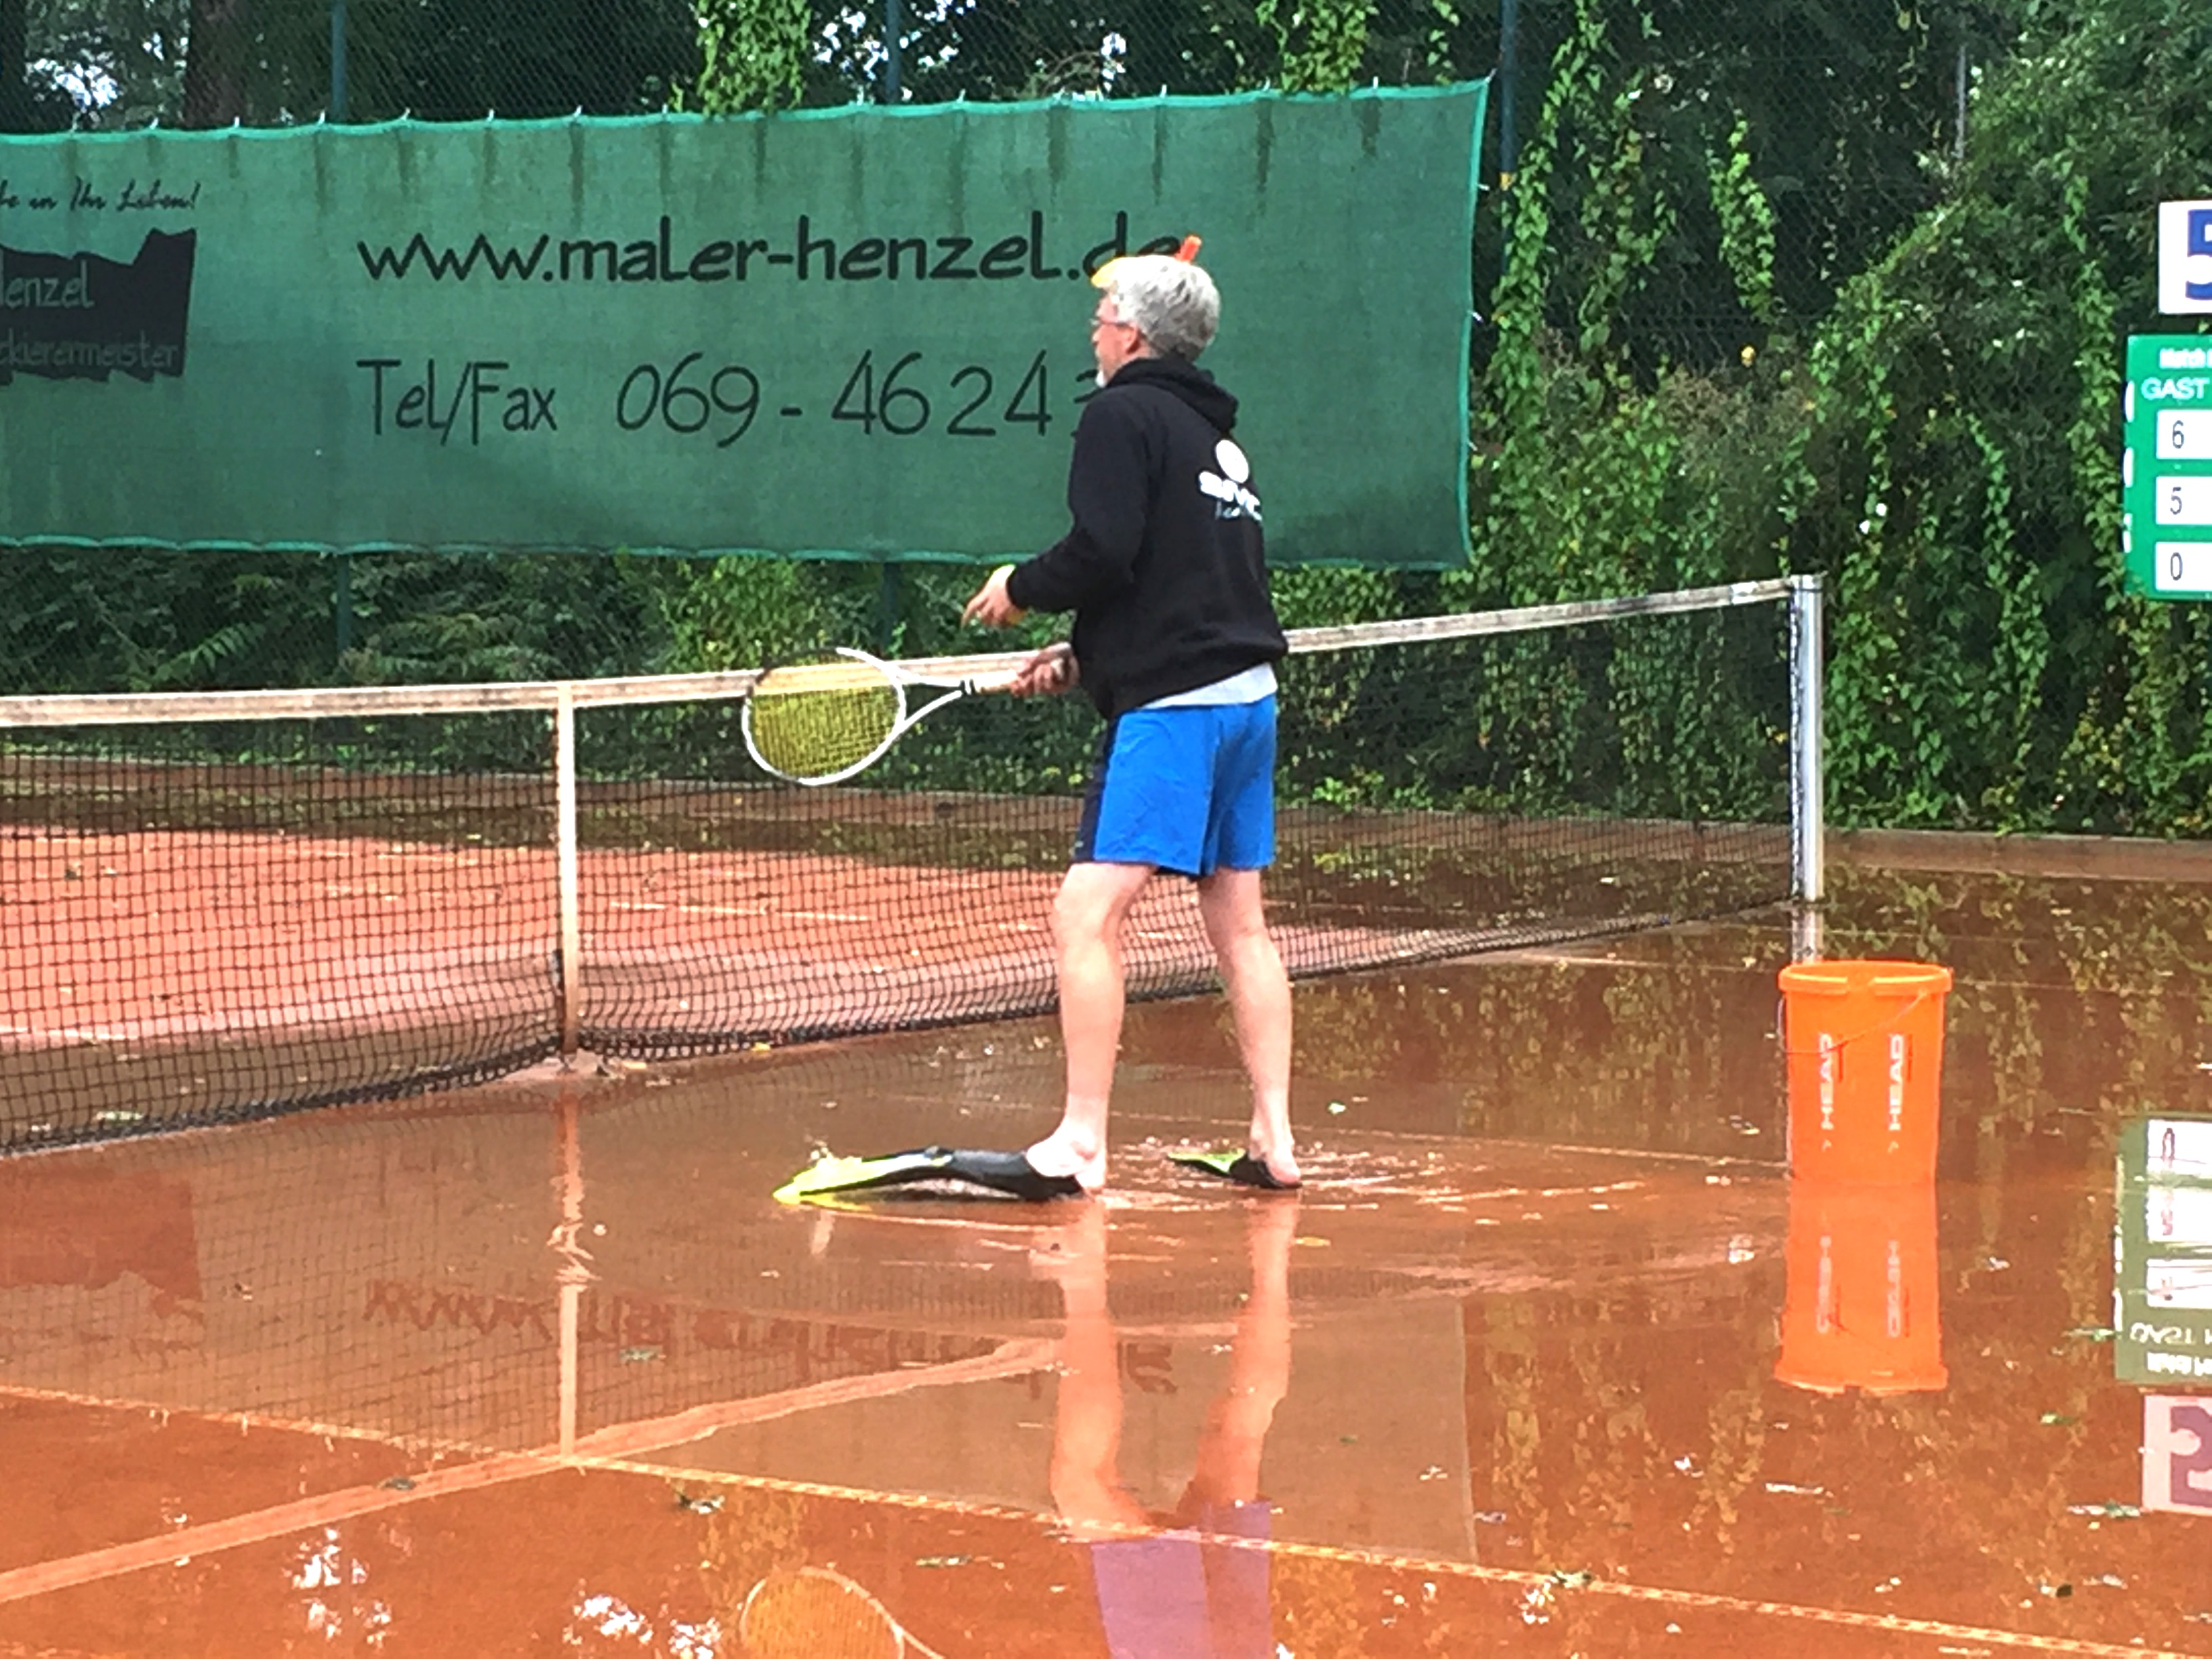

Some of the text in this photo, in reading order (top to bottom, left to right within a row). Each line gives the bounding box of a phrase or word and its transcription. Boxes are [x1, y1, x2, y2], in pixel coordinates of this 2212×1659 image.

[116, 179, 201, 211] Leben!
[0, 247, 96, 309] enzel
[356, 357, 558, 446] Tel/Fax
[615, 351, 761, 448] 069
[830, 349, 1097, 436] 4624
[2141, 377, 2211, 401] GAST
[2171, 419, 2185, 449] 6
[2169, 486, 2184, 515] 5
[2169, 552, 2184, 581] 0
[1888, 1033, 1904, 1131] HEAD
